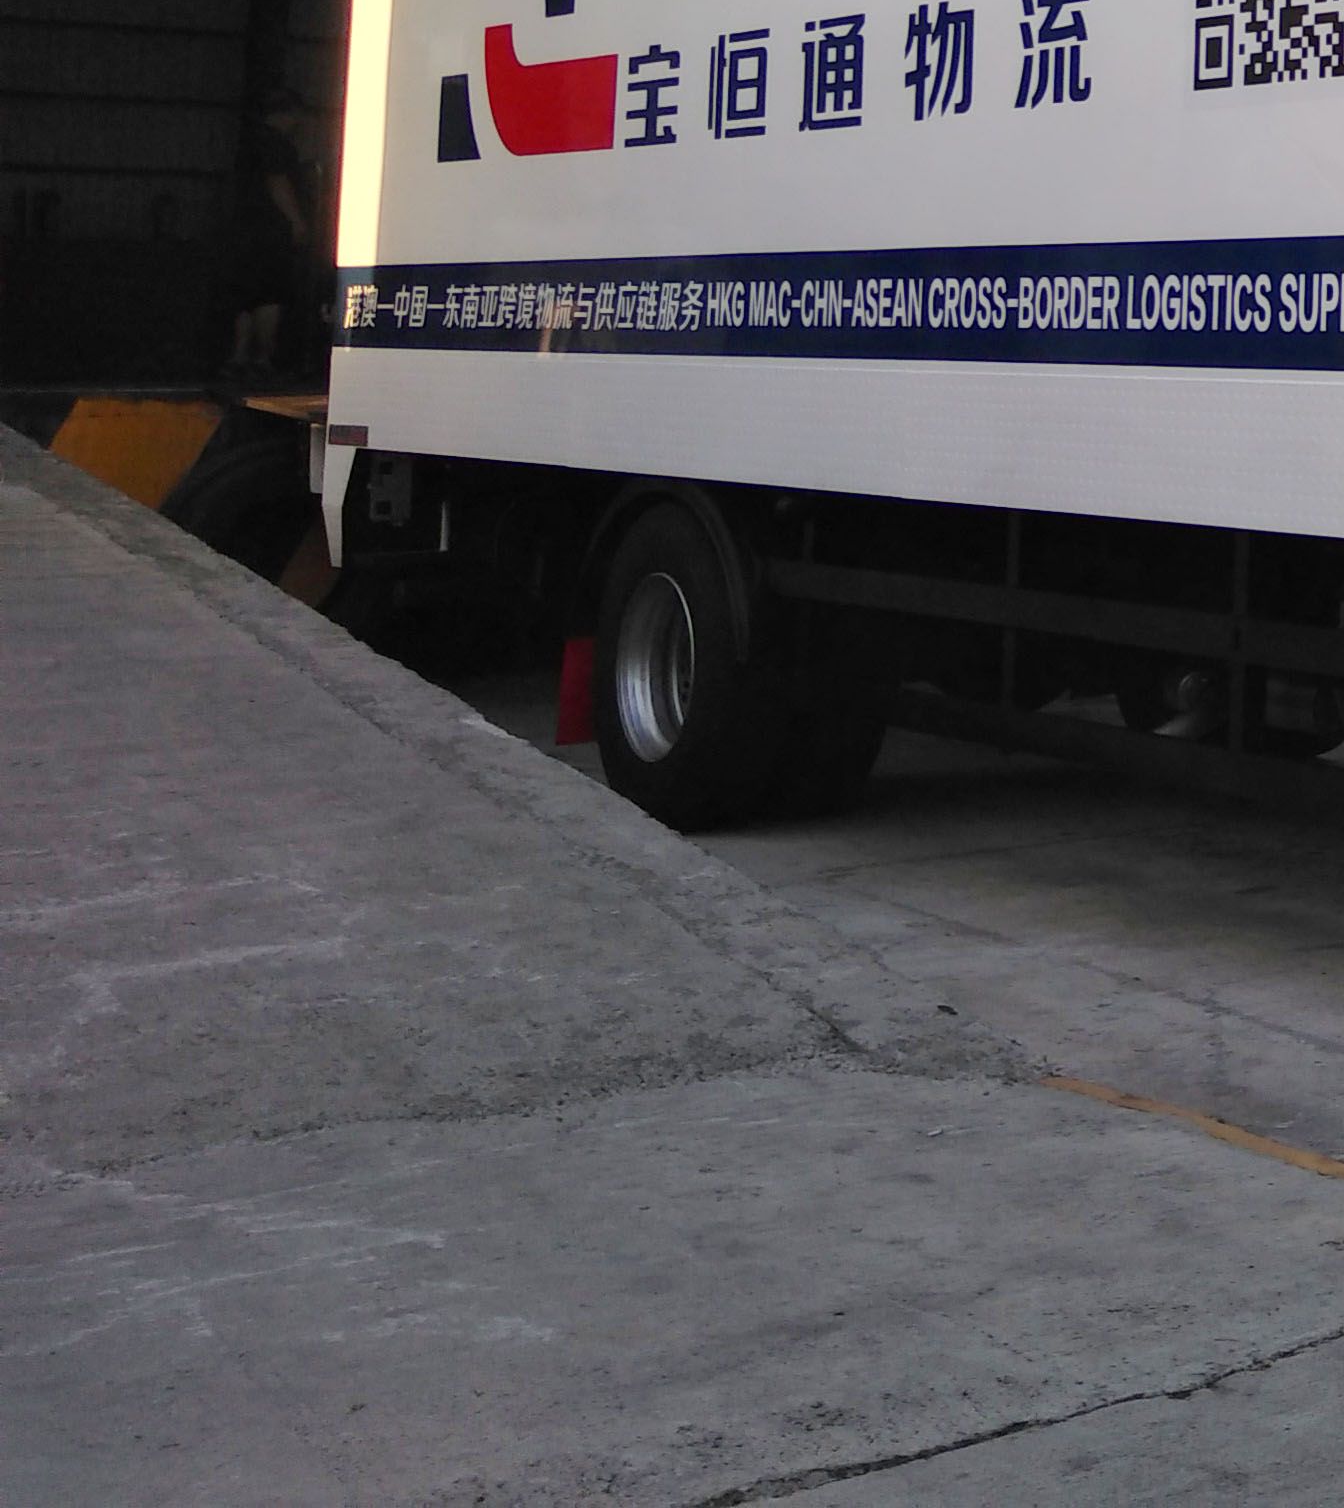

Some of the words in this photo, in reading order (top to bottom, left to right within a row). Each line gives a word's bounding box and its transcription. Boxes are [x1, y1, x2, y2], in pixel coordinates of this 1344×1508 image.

[706, 279, 745, 330] HKG
[748, 276, 924, 330] MAC-CHN-ASEAN
[927, 275, 1121, 332] CROSS-BORDER
[1126, 274, 1272, 333] LOGISTICS
